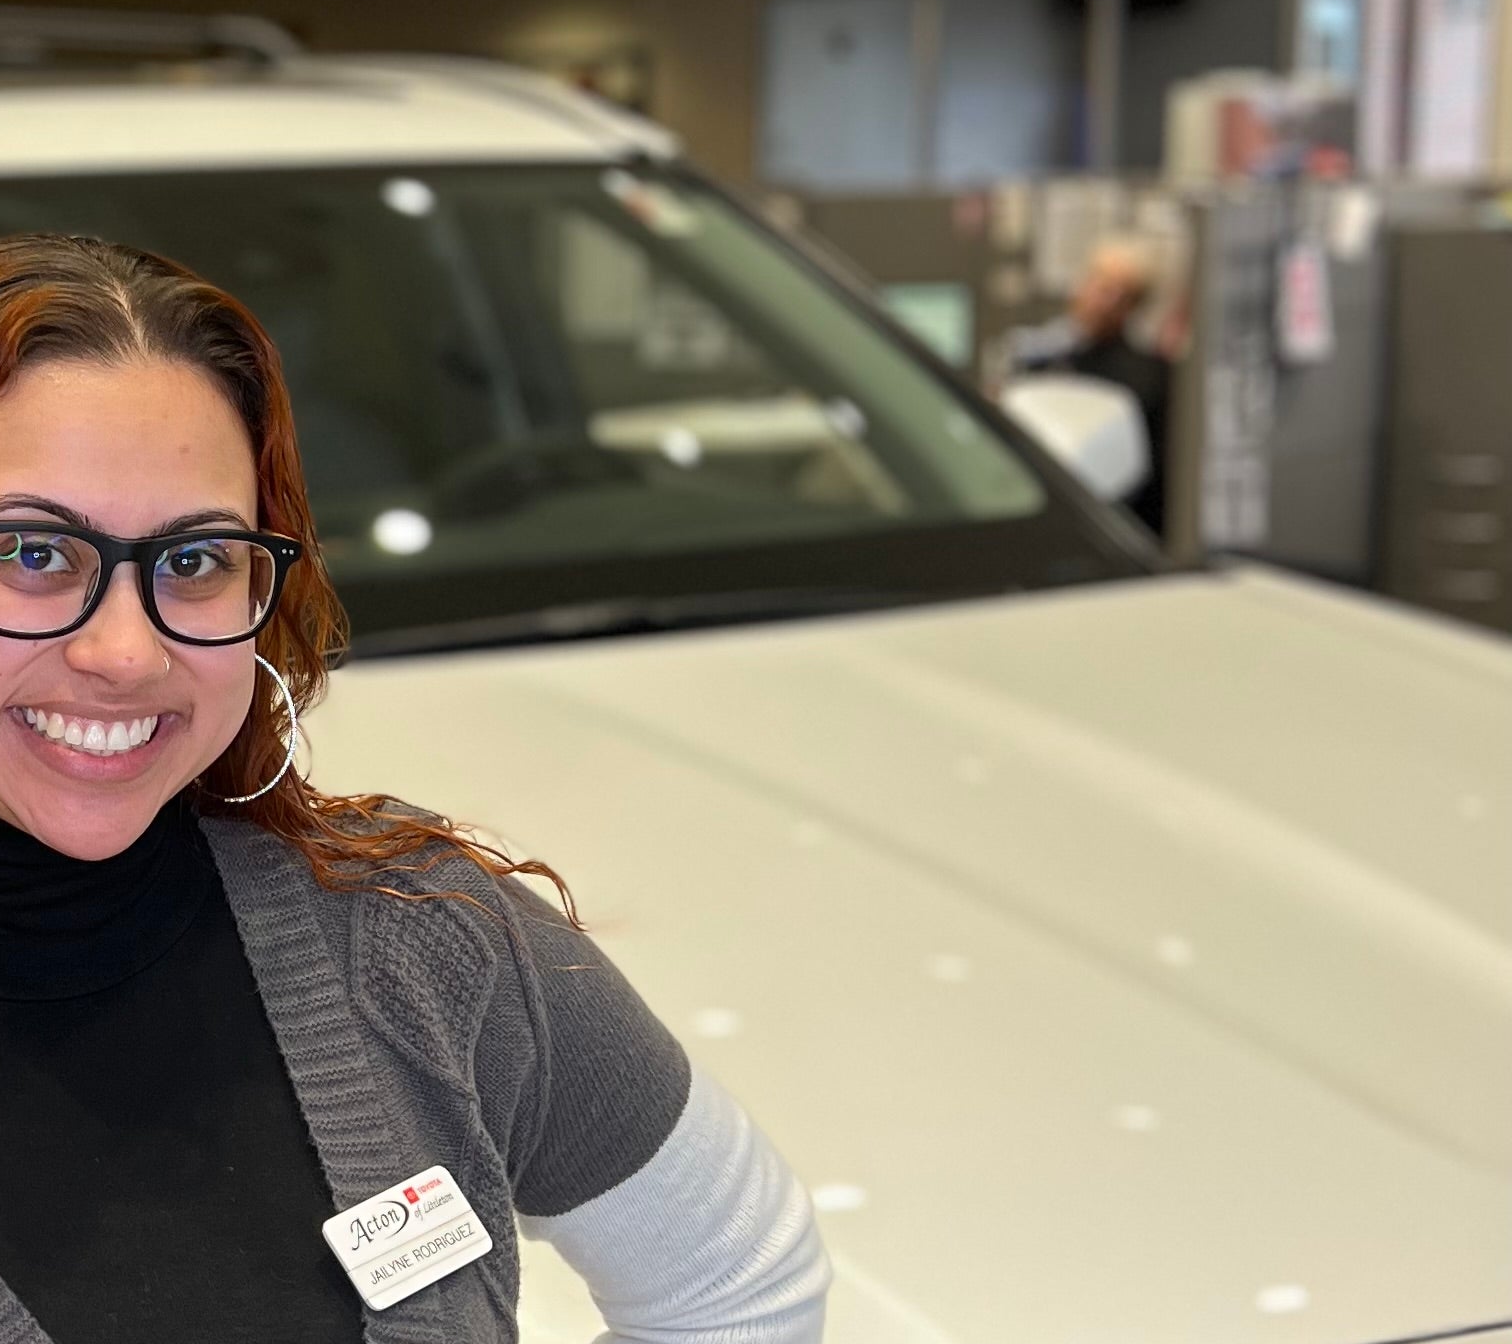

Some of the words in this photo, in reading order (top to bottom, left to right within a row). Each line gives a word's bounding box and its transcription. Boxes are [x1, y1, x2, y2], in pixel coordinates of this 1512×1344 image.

[417, 1178, 442, 1194] TOYOTA
[414, 1204, 424, 1221] of
[349, 1207, 400, 1251] Acton
[370, 1254, 413, 1285] JAILYNE
[412, 1222, 476, 1262] RODRIGUEZ
